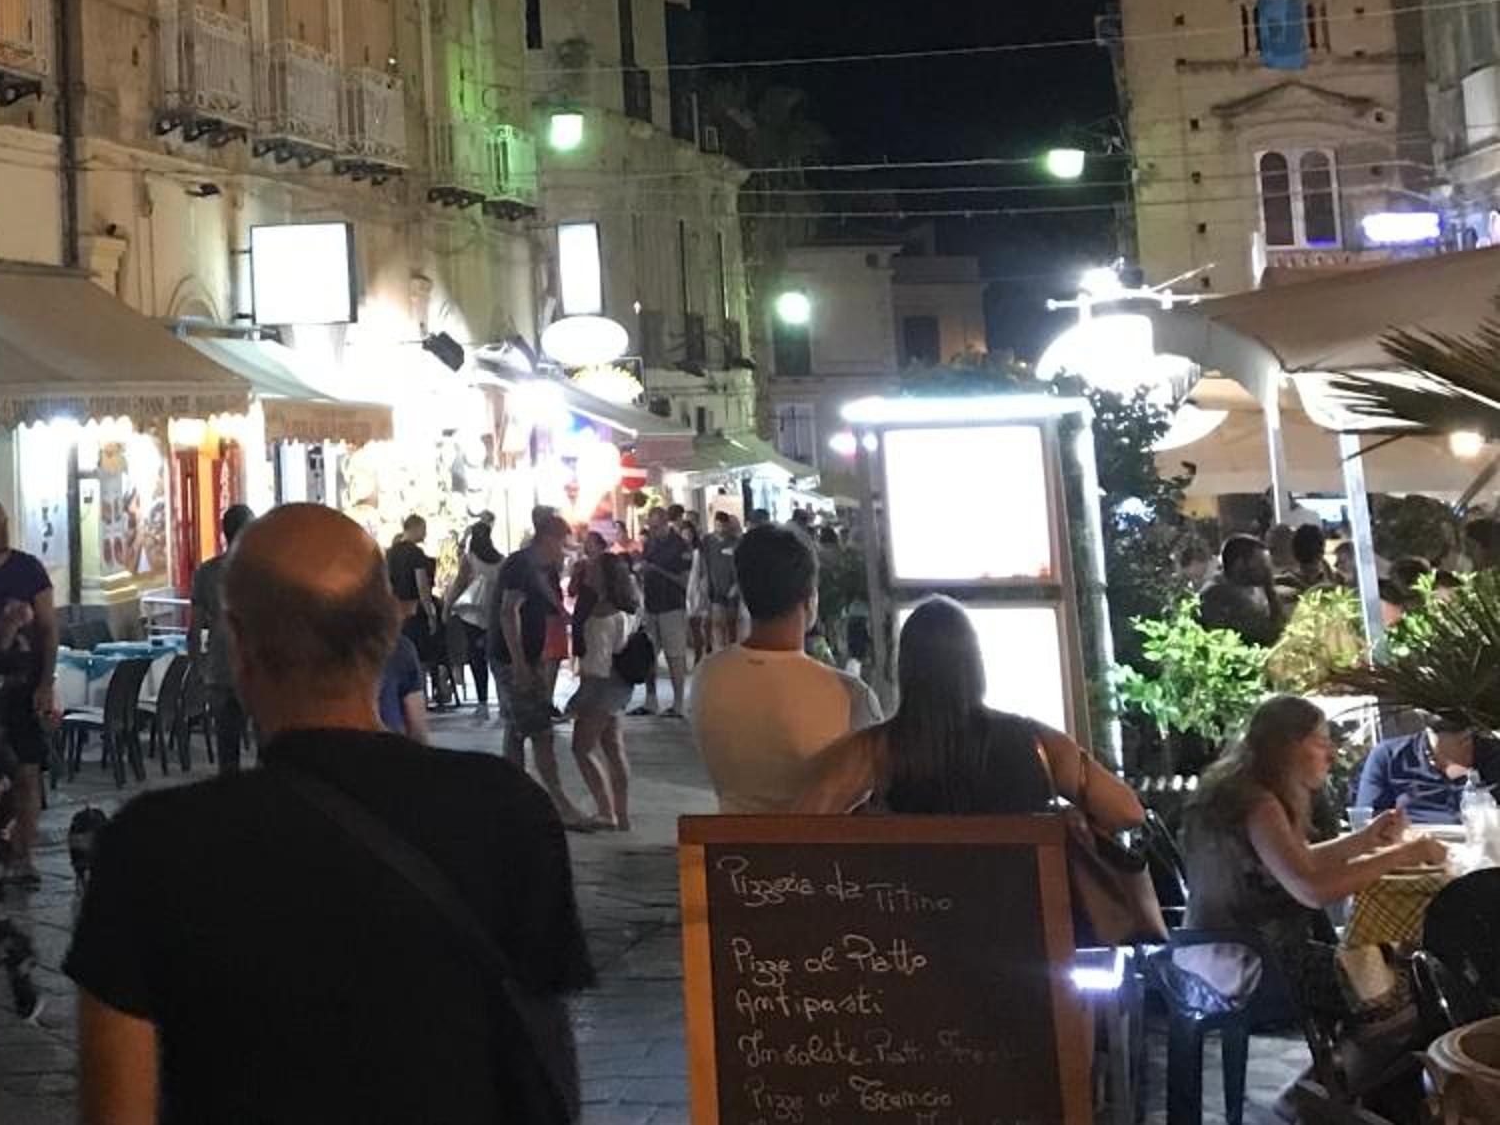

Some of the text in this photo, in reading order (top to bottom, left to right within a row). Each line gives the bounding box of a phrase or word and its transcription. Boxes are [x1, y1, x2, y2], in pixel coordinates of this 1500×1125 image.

[716, 856, 816, 908] Pizzeria
[866, 881, 954, 914] Titino
[731, 937, 794, 987] Pizze
[842, 934, 929, 976] Piatto
[735, 987, 884, 1025] Antipasti
